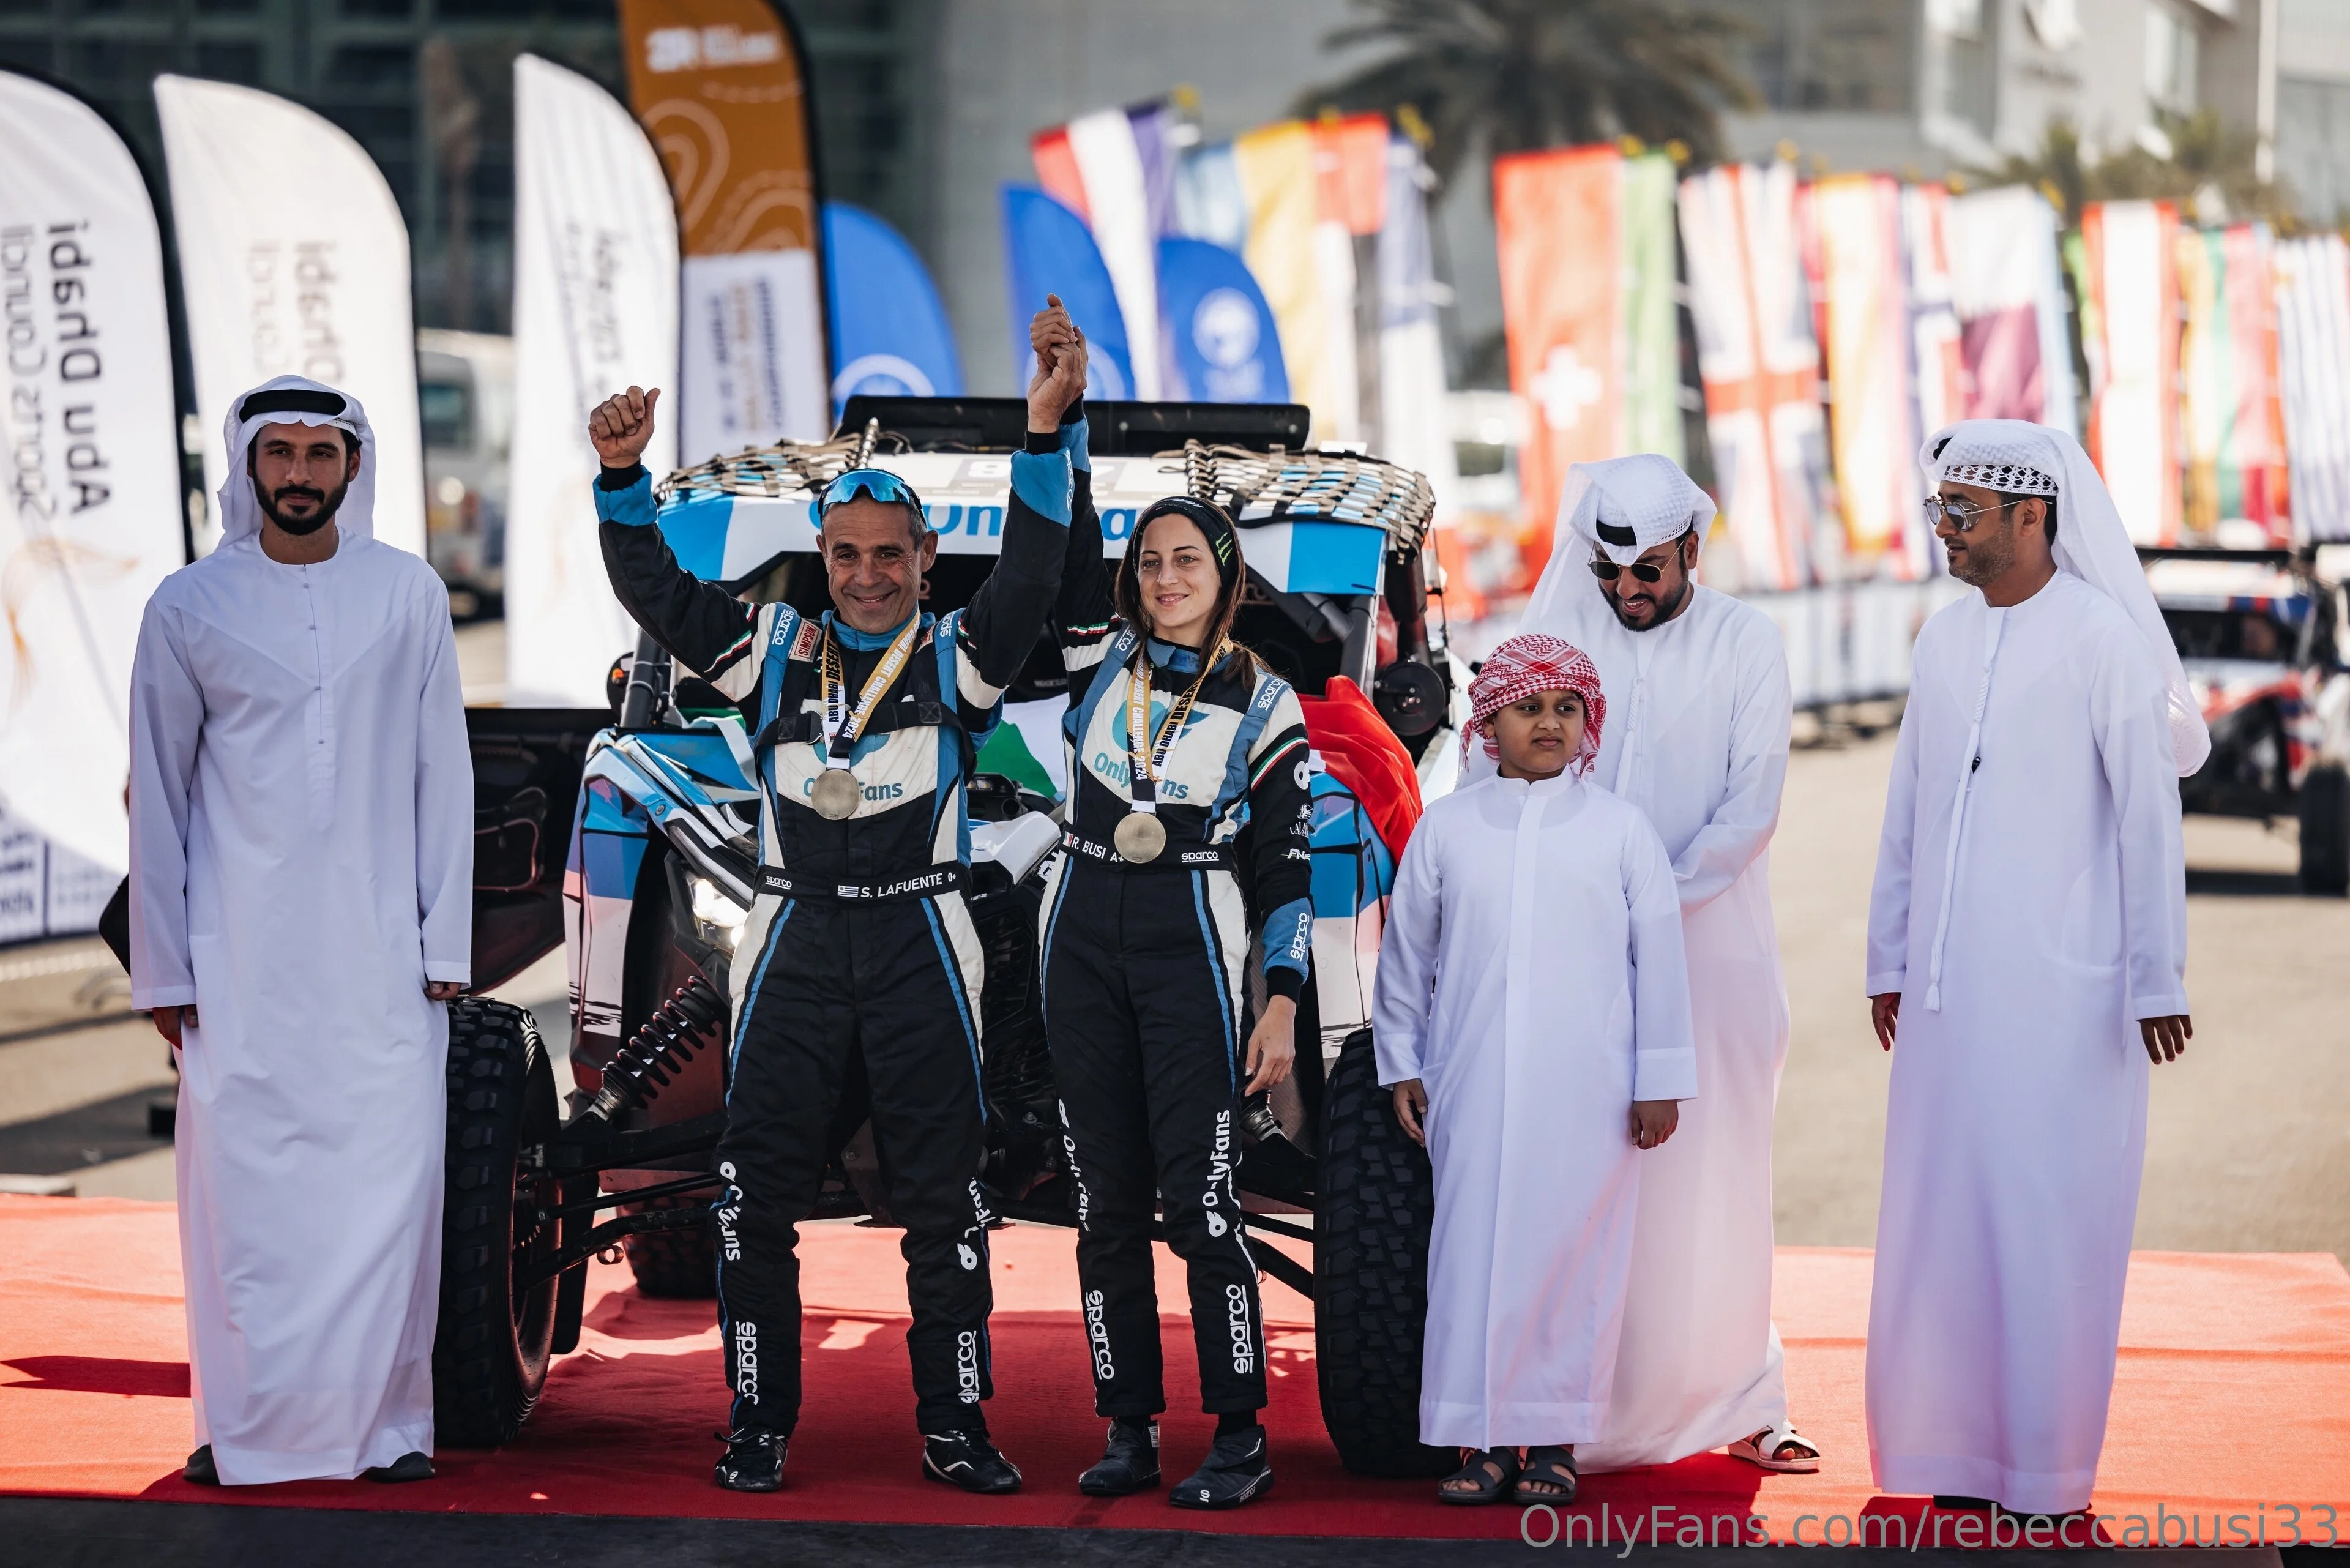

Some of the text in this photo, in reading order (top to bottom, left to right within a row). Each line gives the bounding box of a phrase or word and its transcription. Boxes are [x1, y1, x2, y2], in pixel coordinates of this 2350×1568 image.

[771, 608, 795, 646] sparco
[798, 625, 817, 656] SIMPSON
[881, 648, 904, 678] DESERT
[828, 681, 839, 704] DHABI
[854, 676, 887, 715] CHALLENGE
[1133, 681, 1145, 706] DESERT
[1257, 679, 1286, 711] sparco
[828, 707, 839, 722] ABU
[842, 717, 862, 739] 2024
[1132, 706, 1145, 753] CHALLENGE
[1152, 748, 1167, 767] ABU
[1162, 721, 1179, 749] DHABI
[1094, 752, 1189, 799] Onlyns
[1135, 755, 1147, 780] 2024
[1070, 836, 1124, 862] R. BUSI A+
[1181, 851, 1219, 863] sparco
[765, 875, 792, 890] sparco
[860, 887, 873, 898] S.
[877, 872, 943, 897] LAFUENTE
[1290, 912, 1310, 963] sparco
[1085, 1290, 1114, 1381] sparco
[1226, 1284, 1253, 1374] sparco
[958, 1330, 979, 1404] sparco
